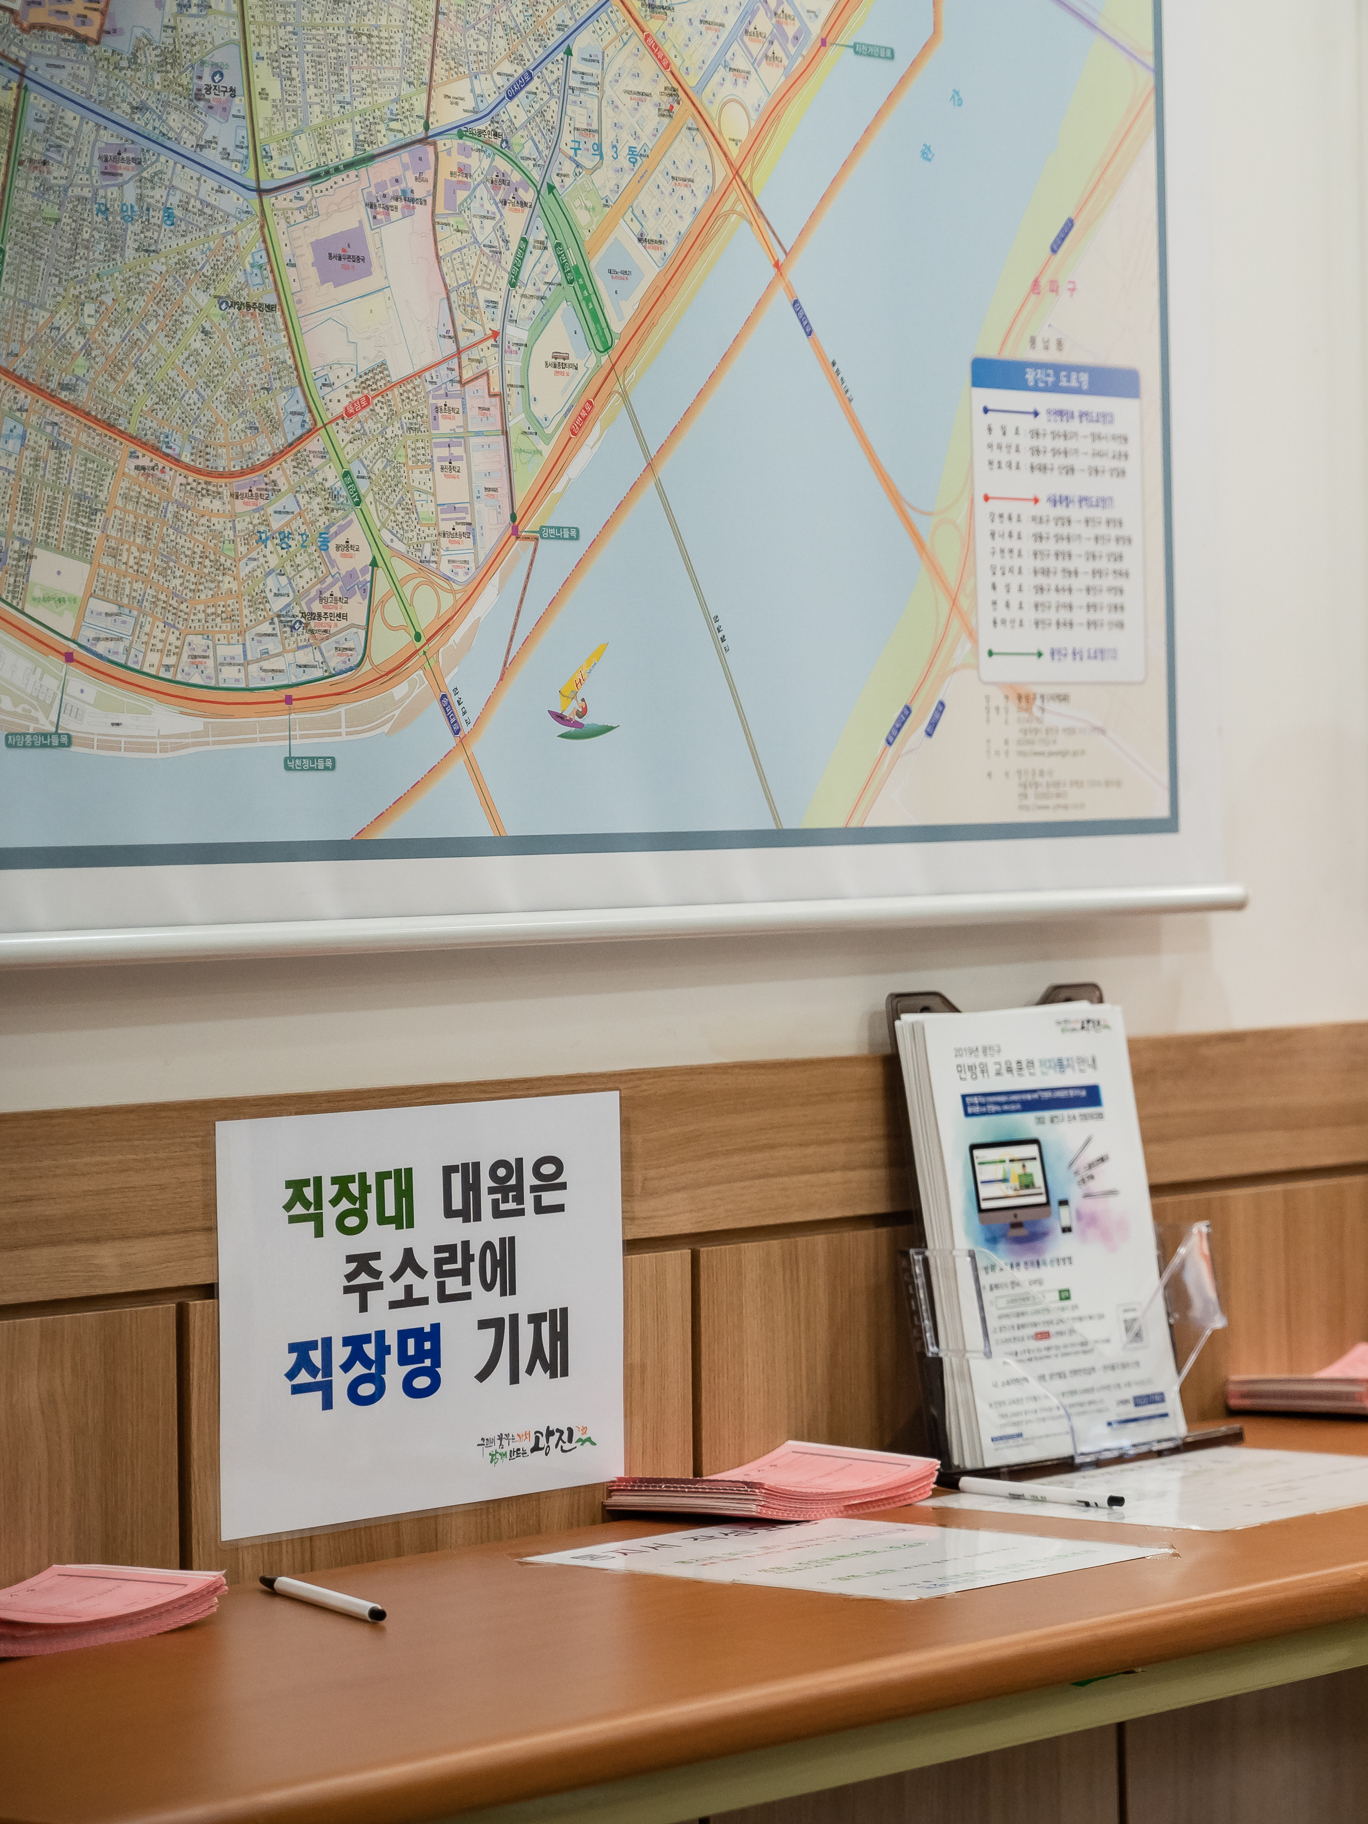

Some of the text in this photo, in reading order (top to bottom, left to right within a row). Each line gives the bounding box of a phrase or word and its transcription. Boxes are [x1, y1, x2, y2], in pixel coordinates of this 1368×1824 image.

[204, 84, 237, 98] 광진구청
[507, 73, 533, 98] 아차산로
[327, 252, 366, 264] 동서울우편집중국
[544, 360, 579, 371] 동서울종합터미널
[1024, 367, 1090, 390] 광진구 도로명
[347, 397, 368, 415] 뚝섬로
[572, 401, 592, 434] 강변북로
[541, 527, 577, 538] 강변나들목
[335, 543, 360, 553] 광양중학교
[299, 611, 348, 622] 자양2동주민센터
[712, 614, 731, 654] 잠실철교
[451, 686, 472, 727] 잠실대교
[7, 733, 69, 747] 자양중앙나들목
[286, 757, 333, 770] 낙천정나들목
[954, 1044, 1002, 1058] 2019년 광진구
[956, 1061, 990, 1081] 민방위
[993, 1057, 1037, 1078] 교육훈련
[1076, 1054, 1098, 1073] 안내
[282, 1155, 568, 1238] 직장대 대원은
[342, 1235, 517, 1314] 주소란에
[283, 1307, 570, 1411] 직장명 기재
[529, 1425, 578, 1457] 광진
[508, 1447, 529, 1461] 만드는
